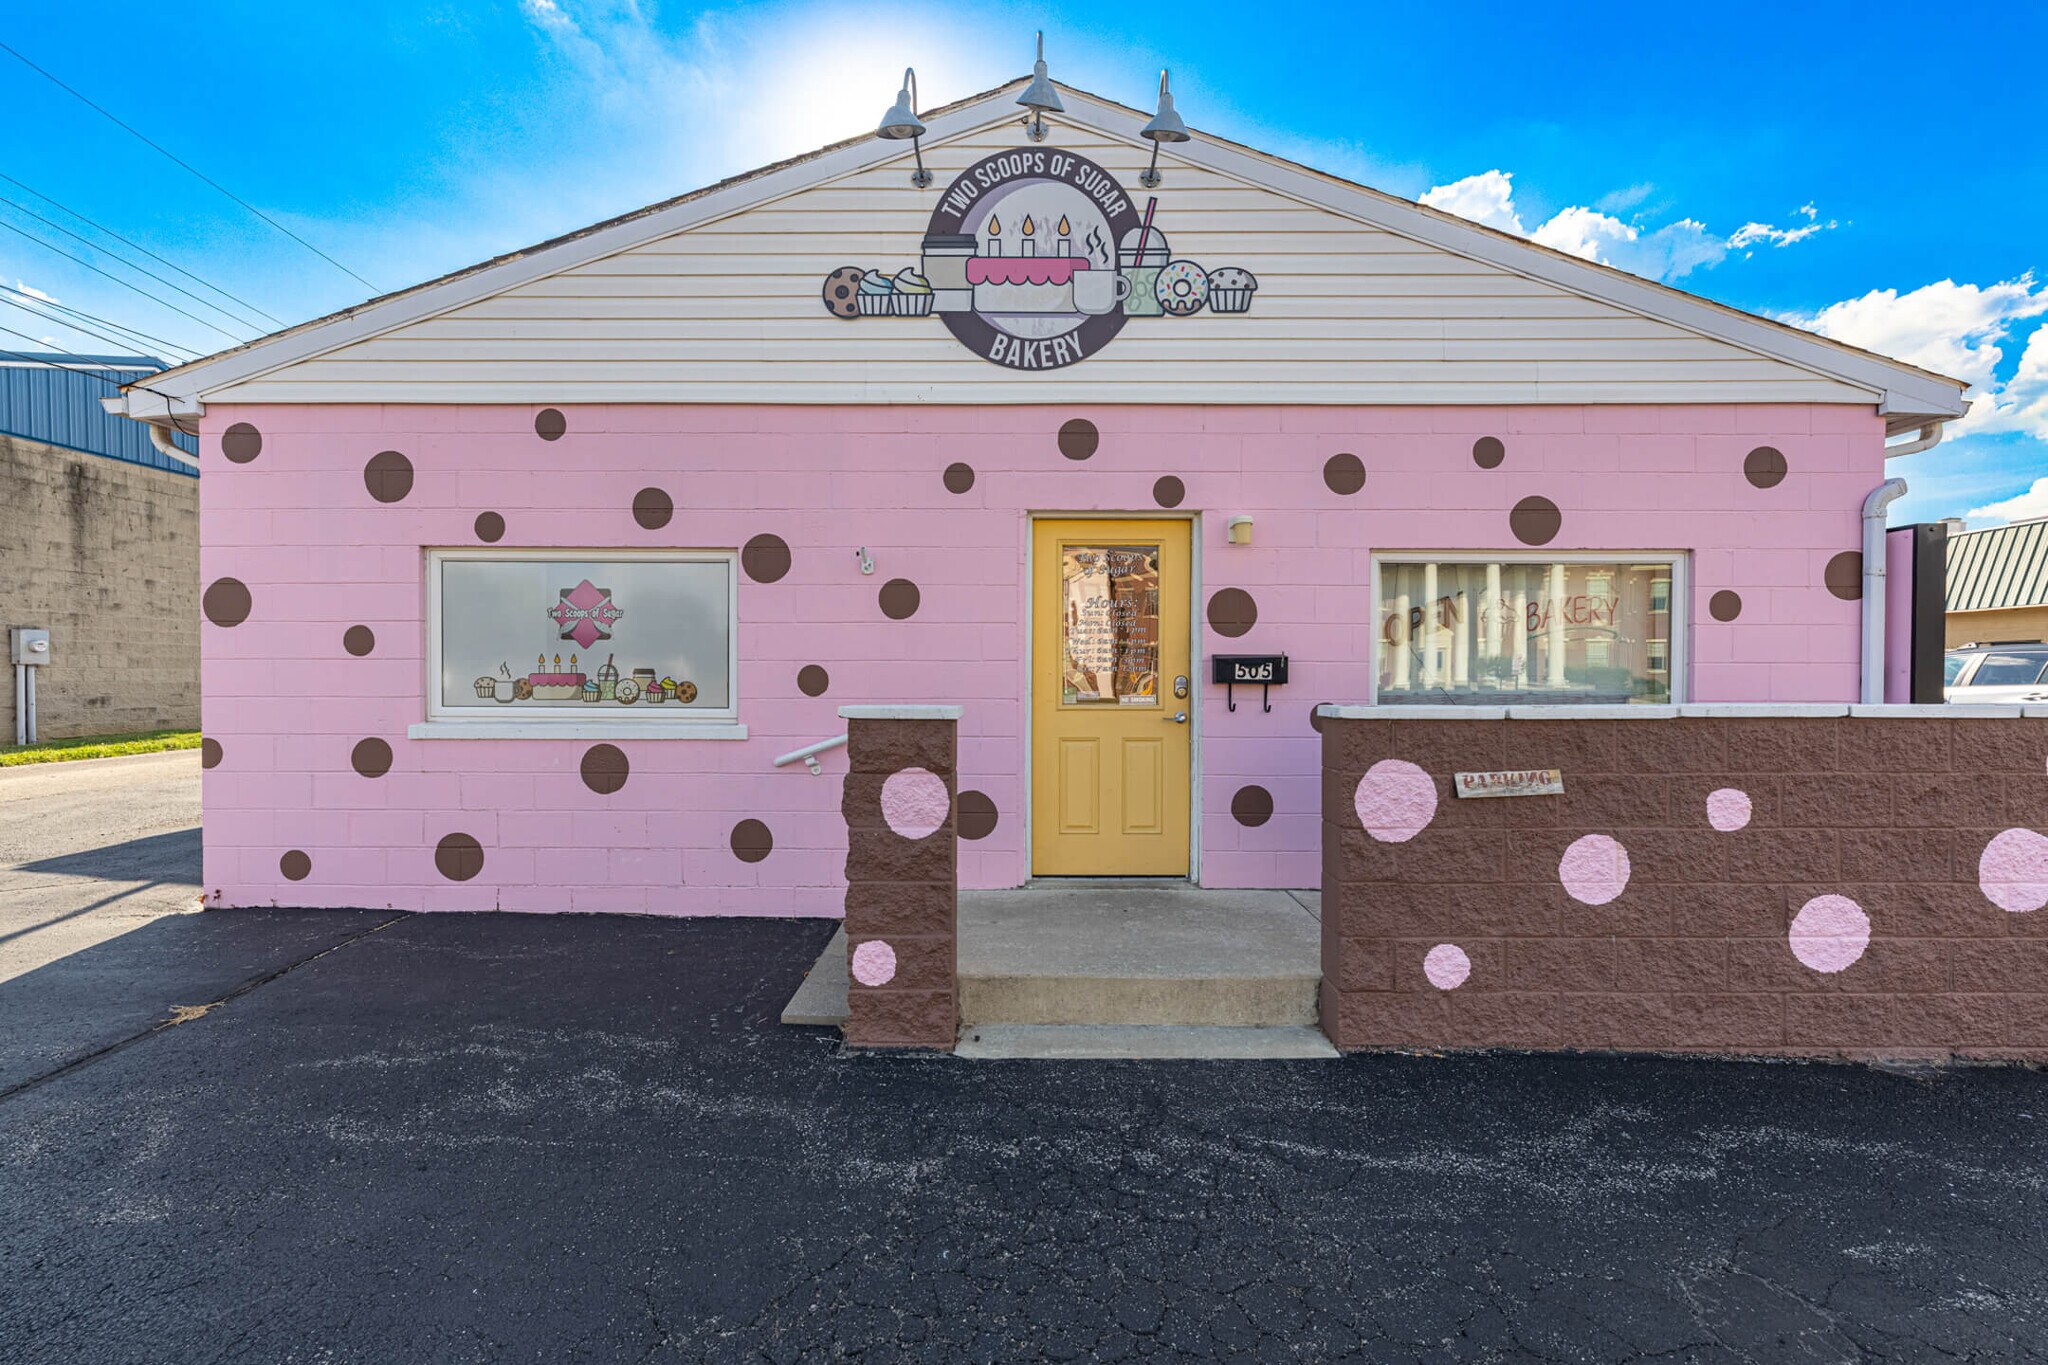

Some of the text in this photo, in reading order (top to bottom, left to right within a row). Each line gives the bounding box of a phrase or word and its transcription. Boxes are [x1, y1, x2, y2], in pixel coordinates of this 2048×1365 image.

[941, 152, 1129, 219] TWO SCOOPS OF SUGAR
[989, 330, 1083, 368] BAKERY
[1099, 564, 1136, 576] Sugar
[1085, 595, 1138, 609] Hours:
[547, 607, 623, 619] Two Scoops of Sugar
[1526, 596, 1619, 631] BAKERY
[1236, 663, 1272, 679] 505
